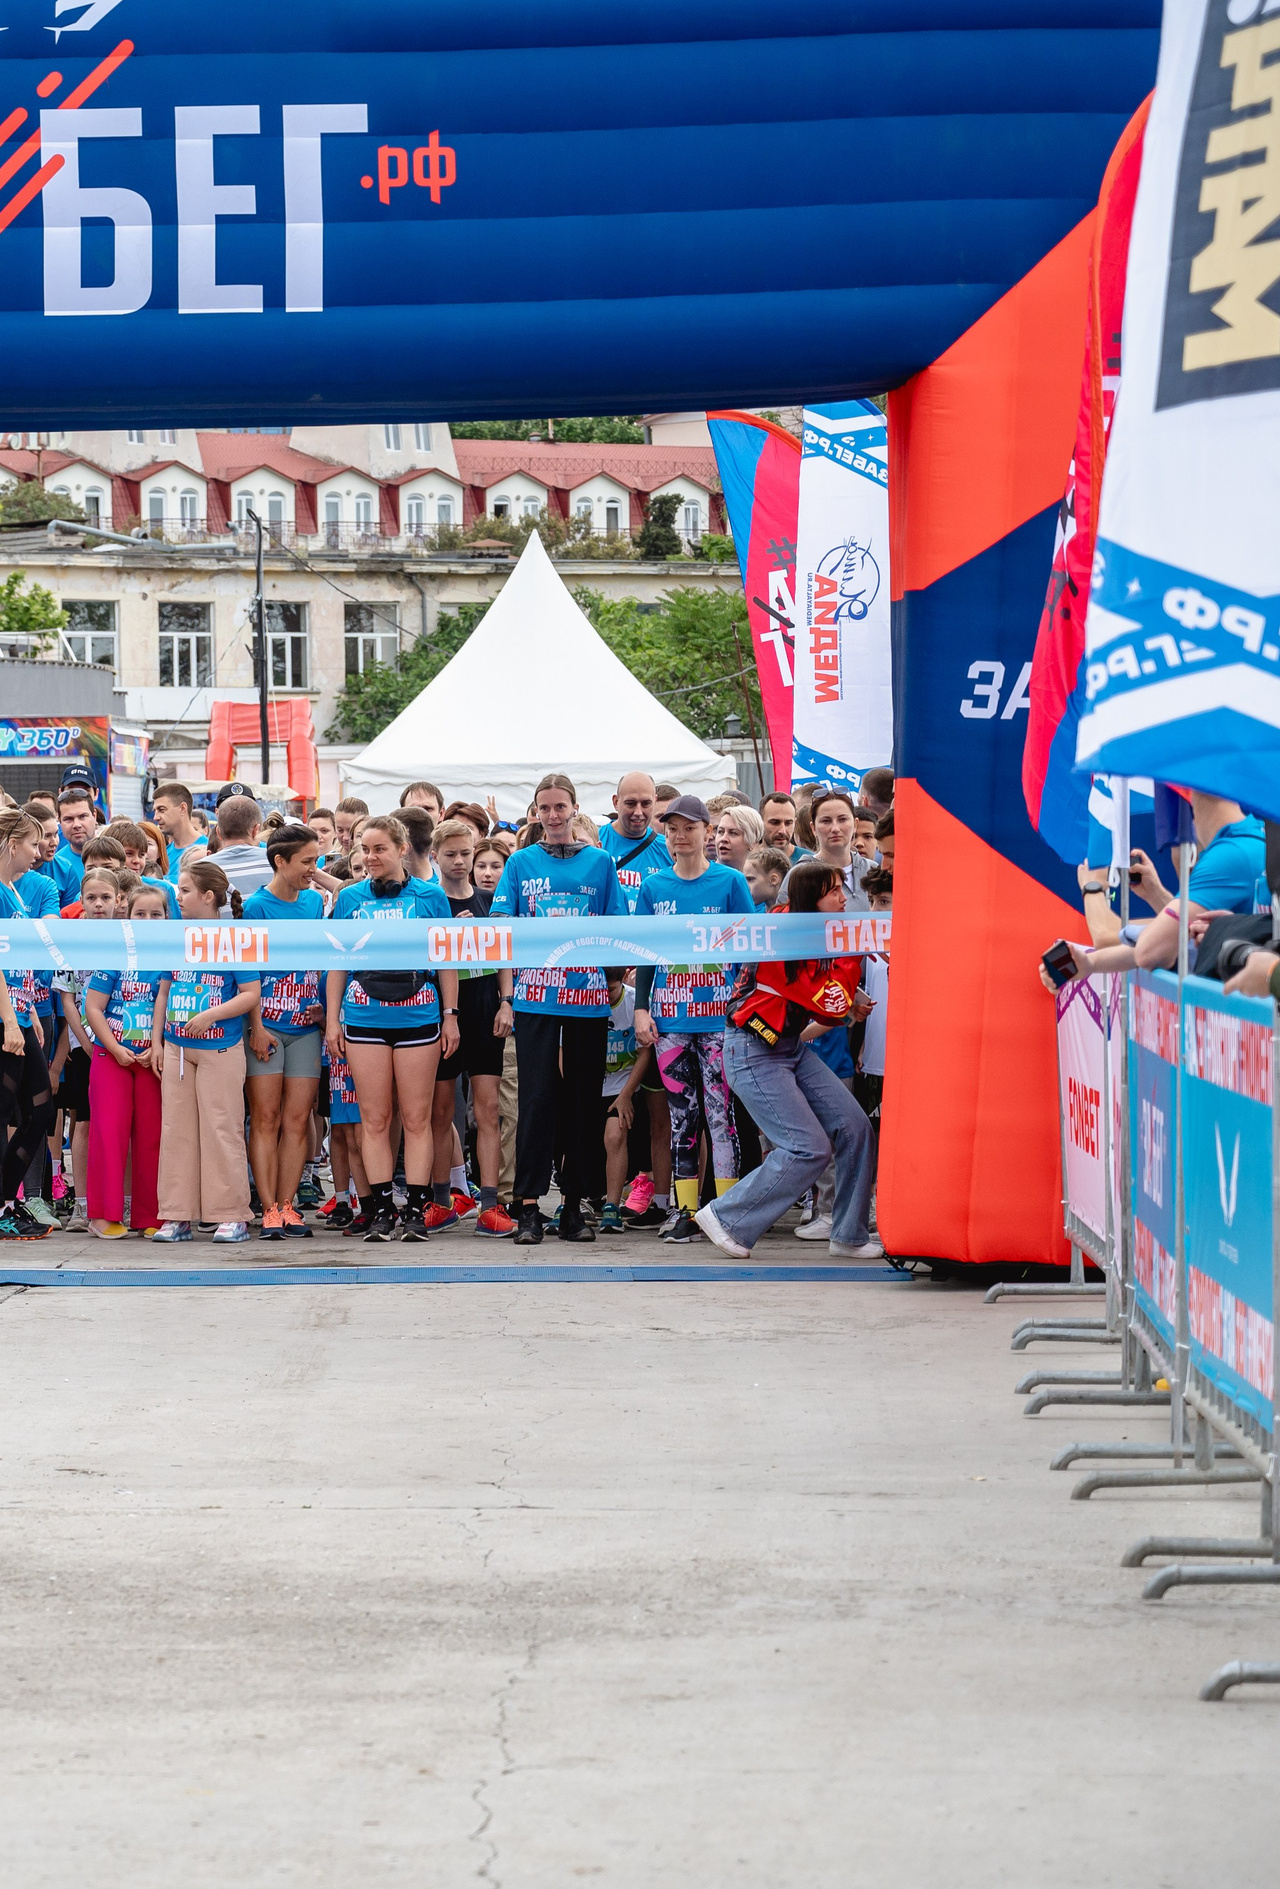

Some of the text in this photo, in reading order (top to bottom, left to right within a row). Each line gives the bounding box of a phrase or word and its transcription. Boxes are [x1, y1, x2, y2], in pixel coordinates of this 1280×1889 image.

[959, 660, 1033, 720] ЗА
[522, 877, 551, 896] 2024
[653, 901, 677, 916] 2024
[184, 926, 269, 963] СТАРТ
[427, 926, 513, 962] СТАРТ
[825, 919, 892, 952] СТАР
[666, 970, 726, 988] #ГОРДОСТЬ
[172, 995, 197, 1010] 10141
[712, 985, 734, 1002] 202
[651, 1002, 678, 1018] ЗАБЕГ
[1068, 1076, 1100, 1160] FONBET
